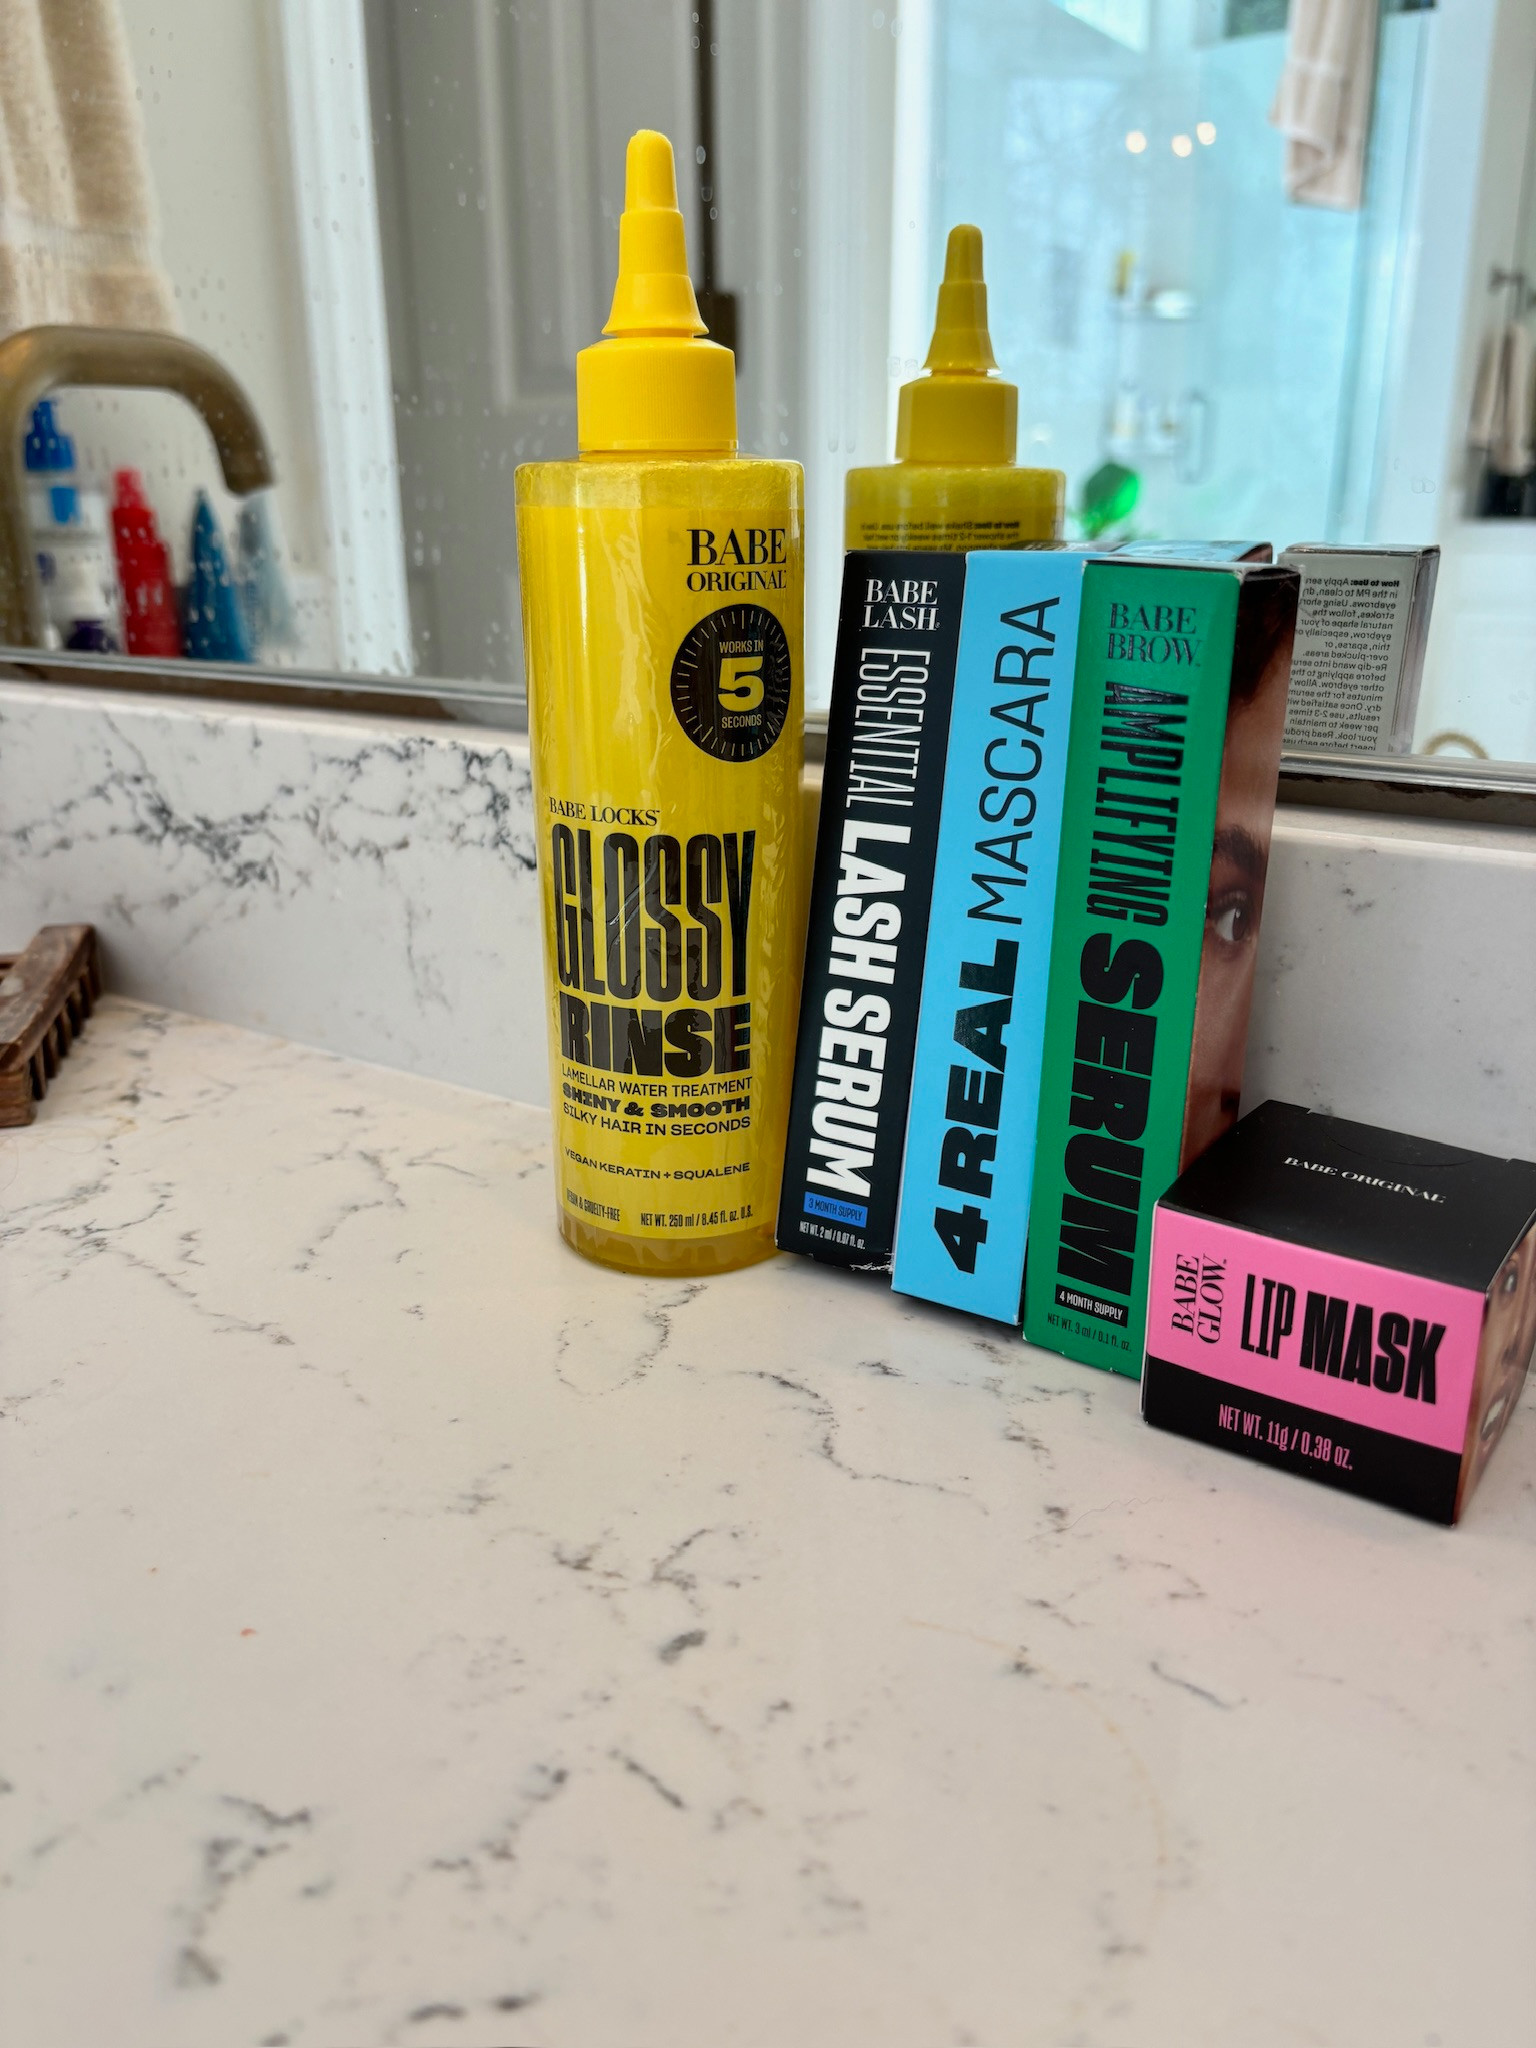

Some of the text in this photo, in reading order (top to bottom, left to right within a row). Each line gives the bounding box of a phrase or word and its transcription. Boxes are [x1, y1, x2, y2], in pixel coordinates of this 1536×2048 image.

[687, 529, 786, 566] BABE
[687, 571, 786, 592] ORIGINAL
[864, 579, 938, 605] BABE
[862, 605, 938, 631] LASH
[1108, 602, 1196, 634] BABE
[720, 640, 763, 653] WORKS IN
[718, 657, 764, 711] 5
[722, 715, 762, 728] SECONDS
[967, 597, 1060, 925] MASCARA
[549, 797, 586, 819] BABE
[552, 823, 756, 1002] GLOSSY
[806, 648, 931, 1198] ESSENTIAL LASH SERUM
[1057, 681, 1189, 1296] AMPLIFYING SERUM
[559, 990, 751, 1078] RINSE
[562, 1064, 752, 1098] LAMELLAR WATER TREATMENT
[563, 1082, 749, 1118] SHINY & SMOOTH
[563, 1102, 750, 1136] SILKY HAIR IN SECONDS
[565, 1147, 597, 1169] VEGAN
[600, 1162, 660, 1179] KERATIN
[674, 1163, 749, 1180] SQUALENE
[1284, 1156, 1446, 1204] BABE ORIGINAL
[641, 1213, 653, 1226] NET
[655, 1214, 667, 1227] WT.
[669, 1215, 683, 1227] 250
[685, 1214, 694, 1226] ml
[696, 1214, 700, 1226] /
[702, 1212, 718, 1225] 8.45
[809, 1198, 862, 1221] 3 MONTH SUPPLY
[799, 1221, 809, 1233] NET
[810, 1223, 819, 1236] WT.
[820, 1226, 824, 1238] 2
[832, 1230, 836, 1241] /
[1060, 1291, 1123, 1320] 4 MONTH SUPPLY
[1171, 1254, 1199, 1336] BABE
[1198, 1254, 1225, 1344] GLOW
[1048, 1312, 1059, 1327] NET
[1062, 1318, 1073, 1332] WT.
[1075, 1322, 1080, 1334] 3
[1082, 1327, 1090, 1338] ml
[1093, 1329, 1096, 1340] /
[1098, 1331, 1109, 1344] 0.1
[1240, 1274, 1446, 1405] LIP MASK
[1219, 1404, 1353, 1471] NET WT. 11g / 0.38 oz.
